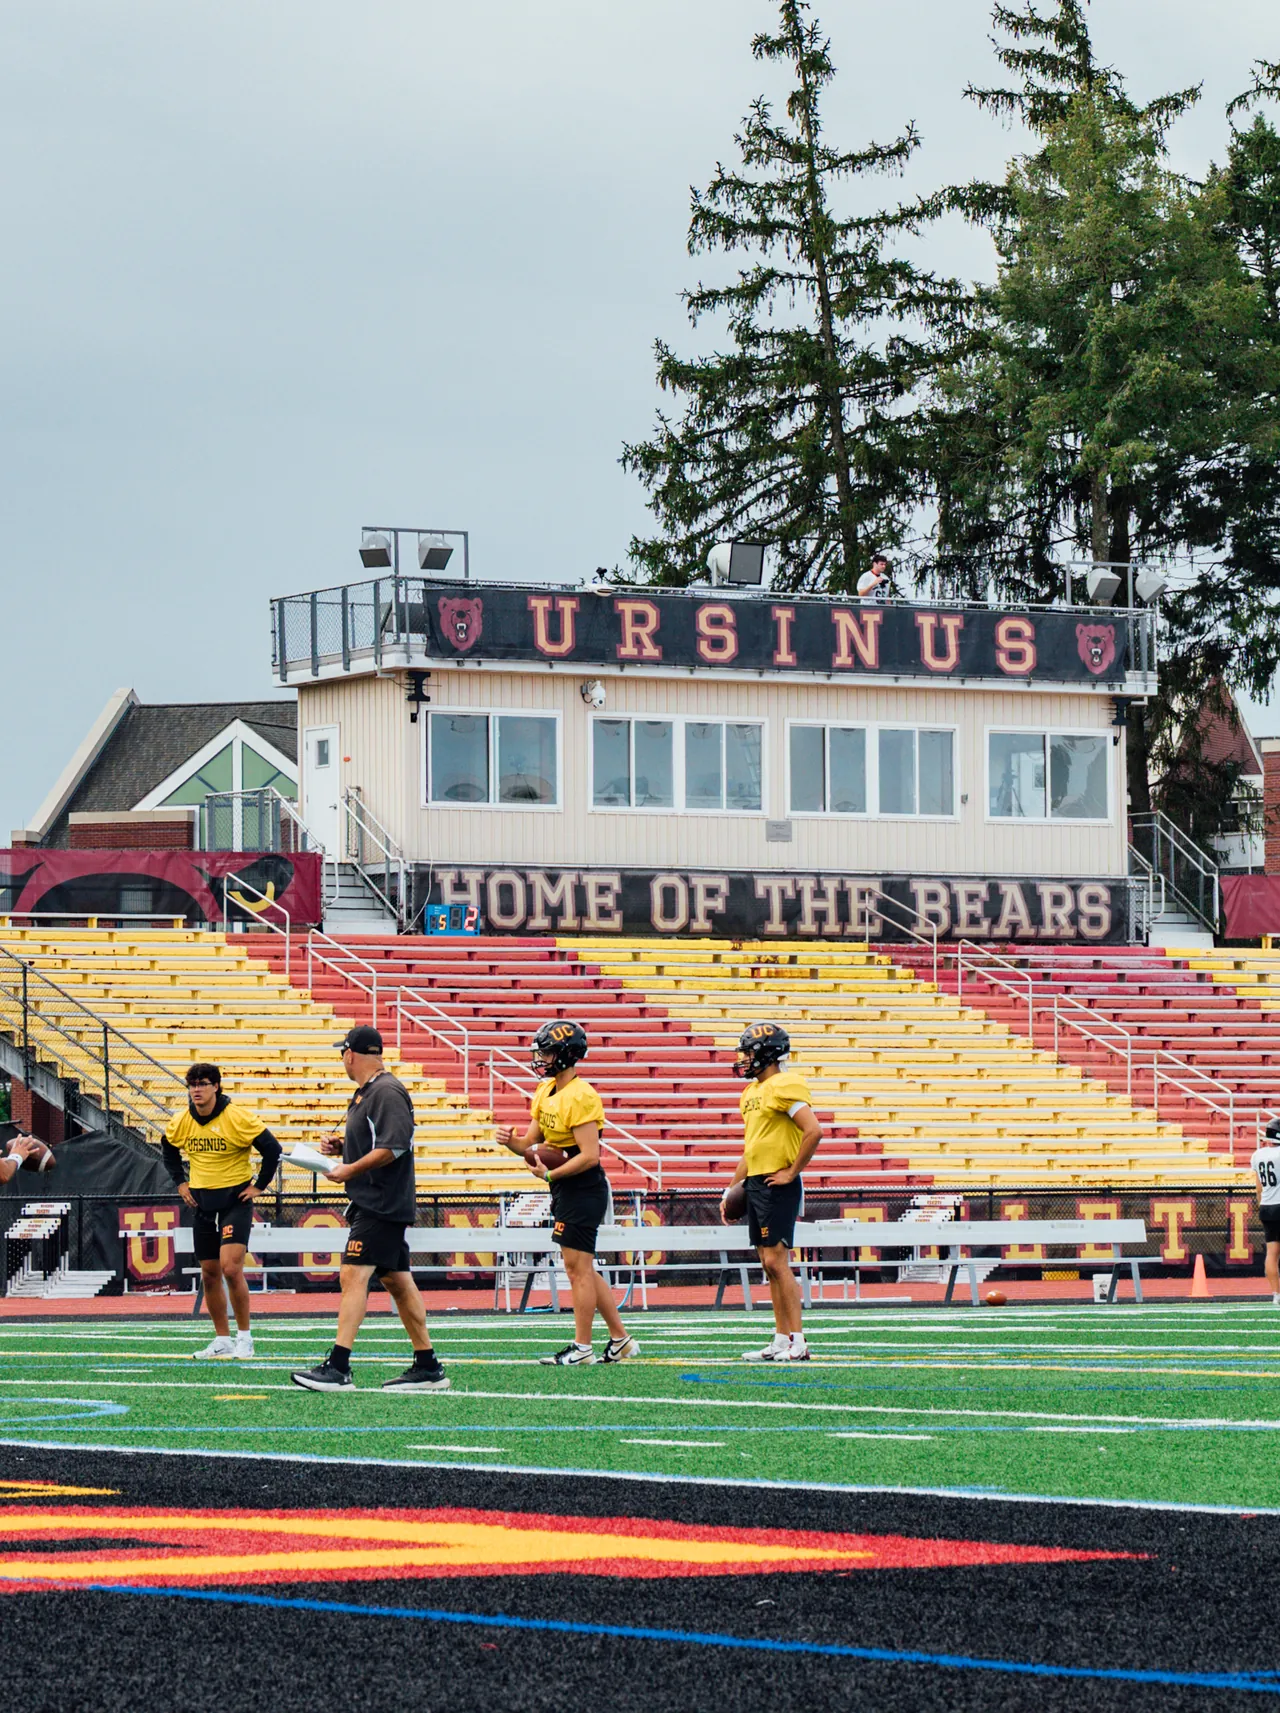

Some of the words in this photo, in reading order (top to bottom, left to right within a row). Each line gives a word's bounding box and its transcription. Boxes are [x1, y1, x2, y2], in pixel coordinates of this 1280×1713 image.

[527, 596, 1037, 675] URSINUS
[435, 870, 623, 931] HOME
[650, 872, 730, 932] OF
[754, 875, 883, 936] THE
[909, 879, 1113, 940] BEARS
[439, 914, 447, 930] 5
[464, 907, 478, 931] 2
[549, 1024, 574, 1041] UC
[750, 1025, 774, 1039] UC
[1258, 1160, 1278, 1188] 86
[348, 1240, 363, 1251] UC
